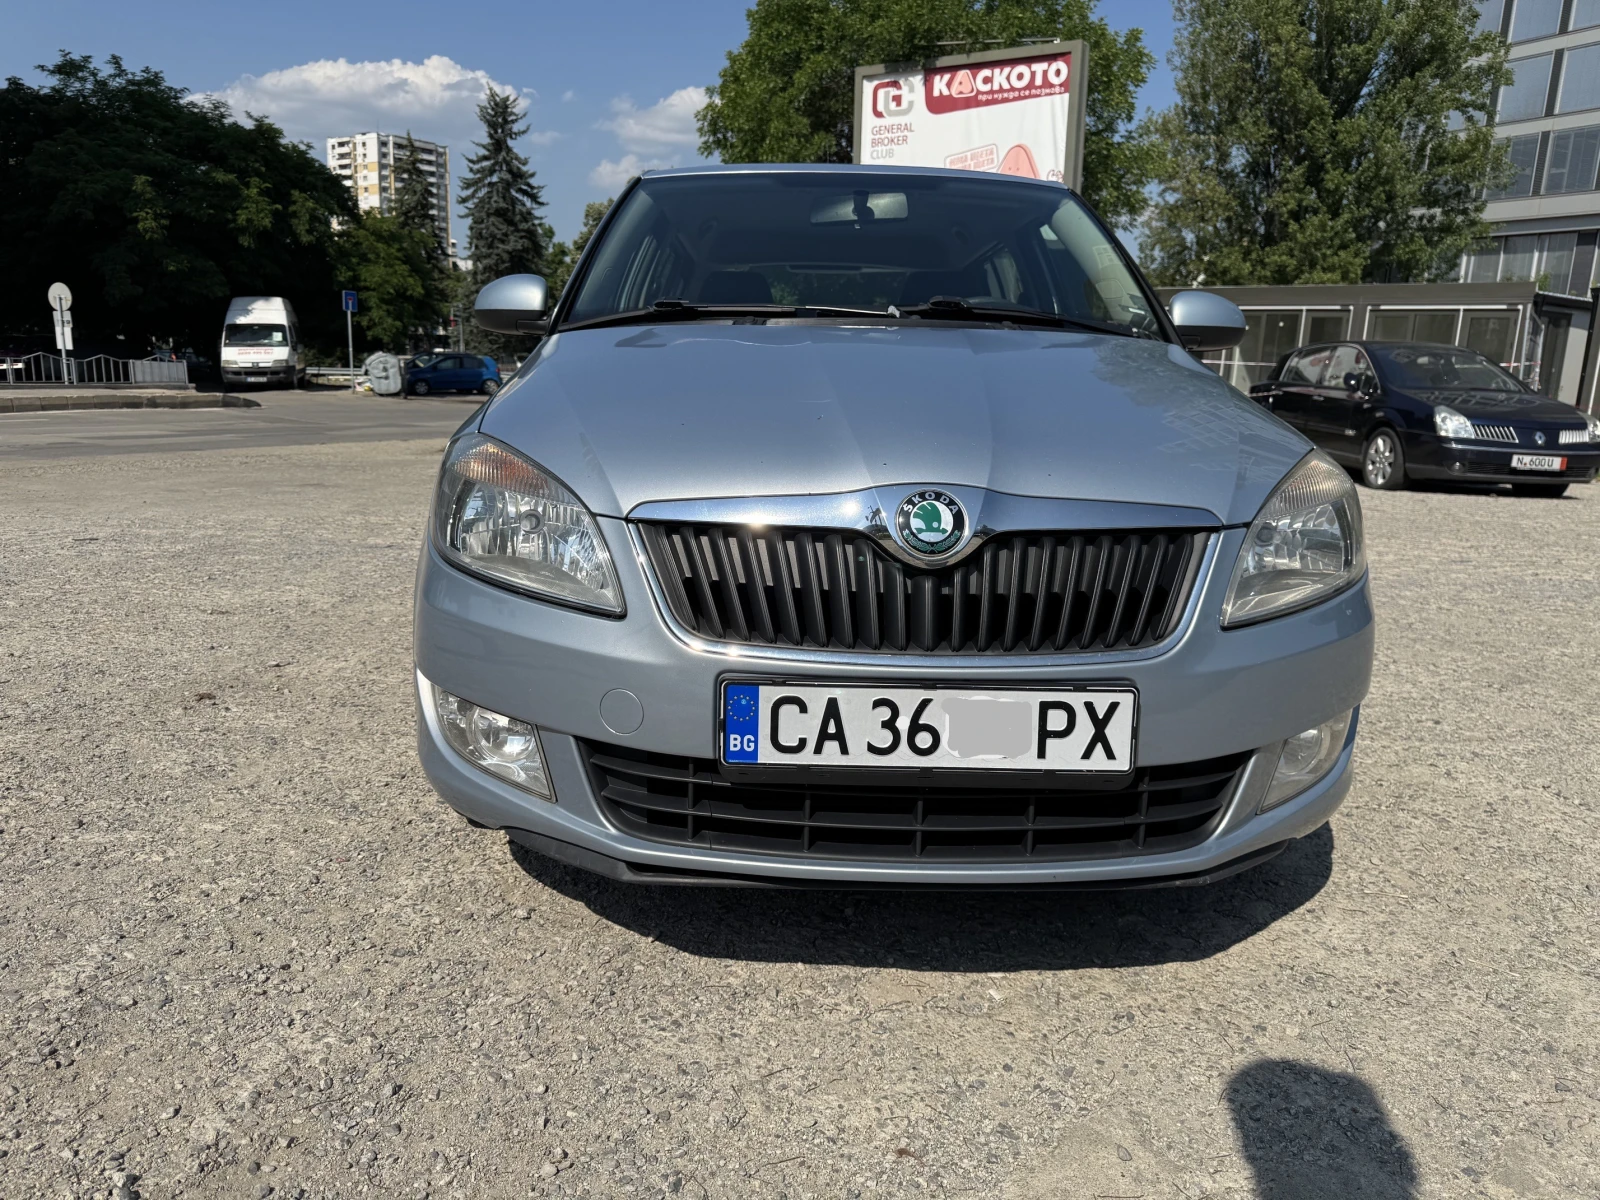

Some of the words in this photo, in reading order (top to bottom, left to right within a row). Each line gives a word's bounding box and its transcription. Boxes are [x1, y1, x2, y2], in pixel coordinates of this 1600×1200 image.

[933, 61, 1068, 98] КАСКОТО
[1020, 89, 1031, 97] се
[871, 122, 915, 136] GENERAL
[871, 135, 908, 148] BROKER
[870, 148, 895, 160] CLUB
[769, 695, 849, 756] CA
[1037, 700, 1120, 761] PX
[729, 733, 755, 752] BG
